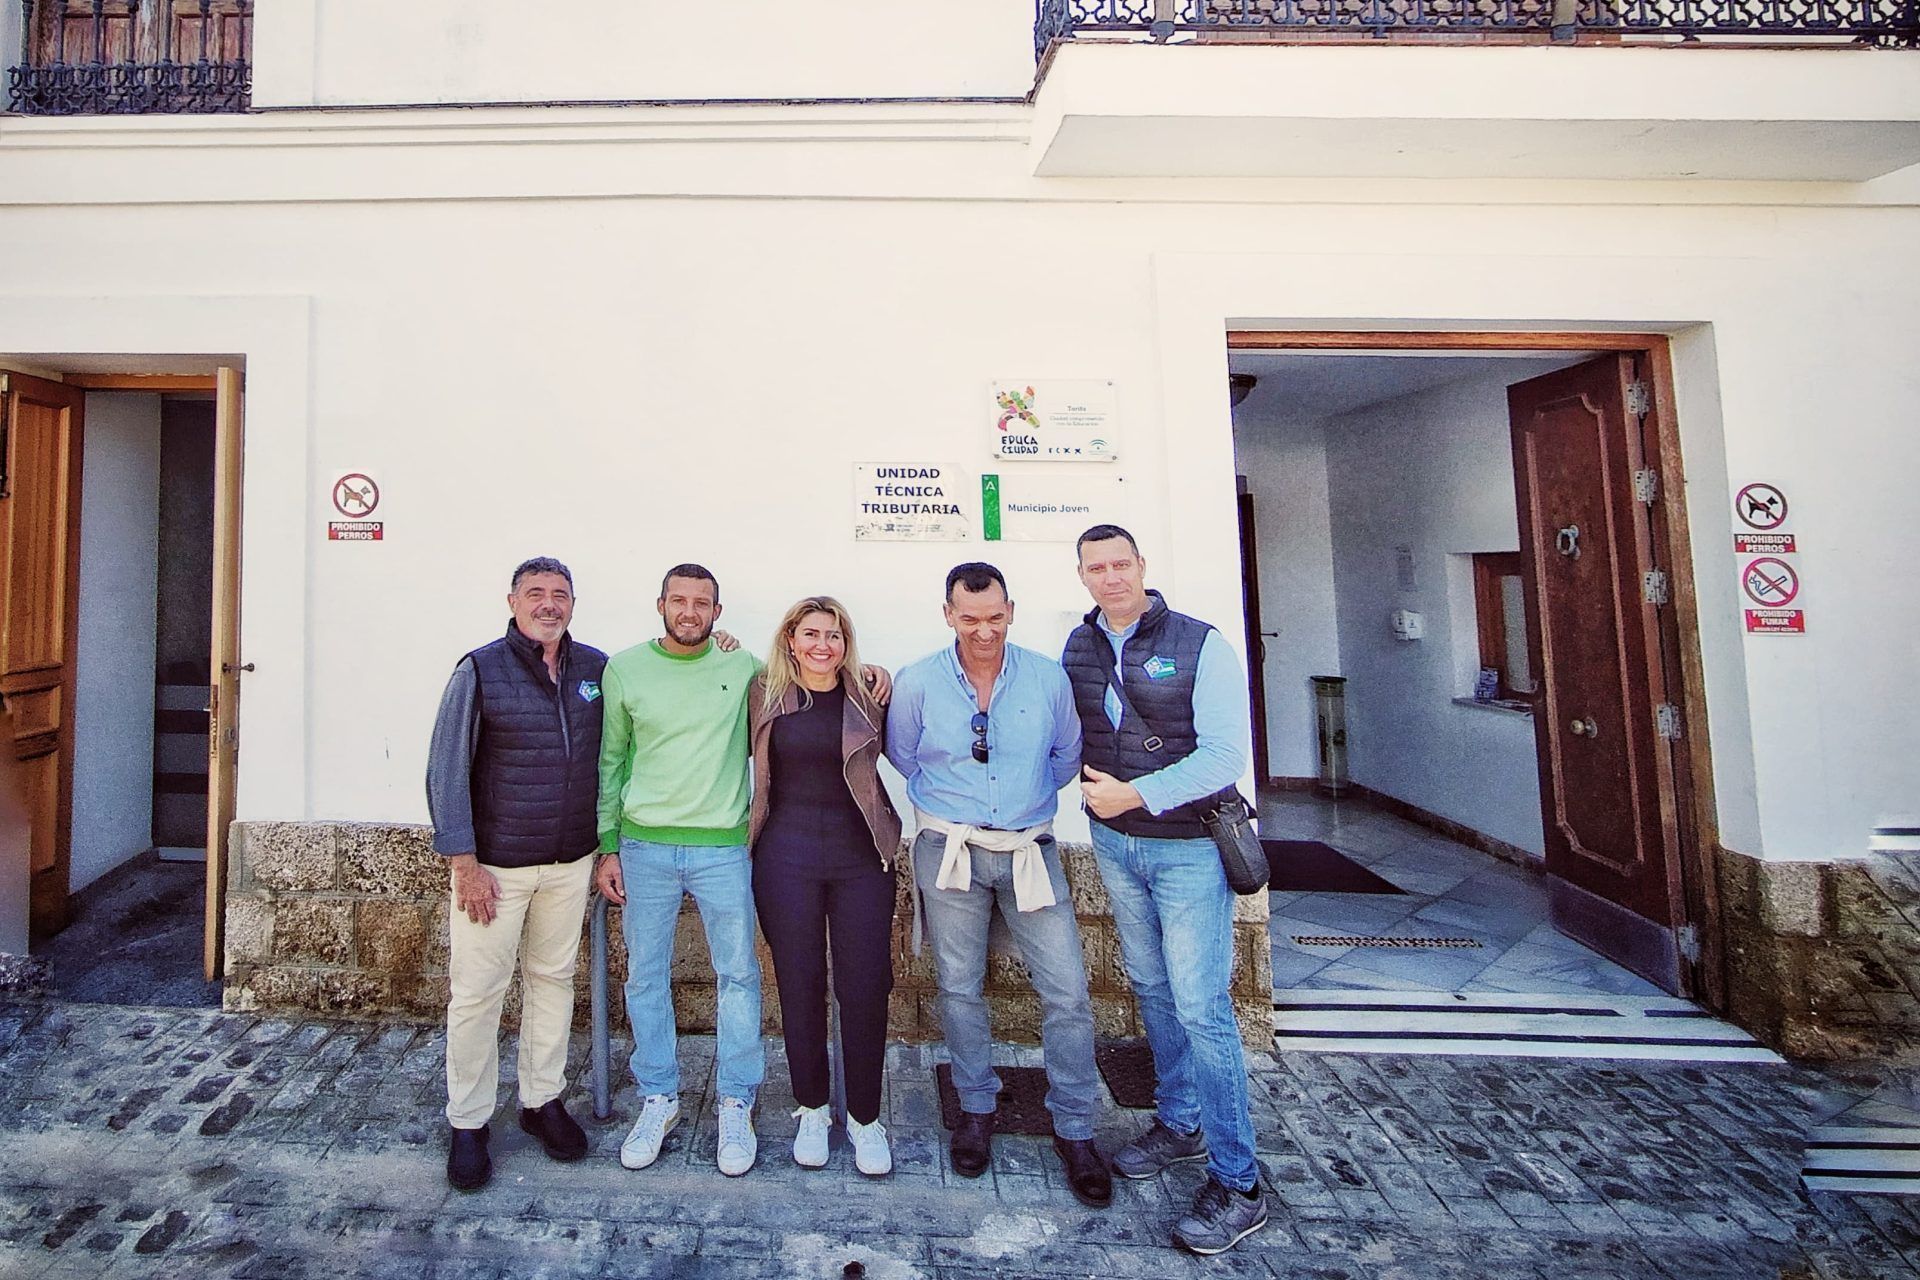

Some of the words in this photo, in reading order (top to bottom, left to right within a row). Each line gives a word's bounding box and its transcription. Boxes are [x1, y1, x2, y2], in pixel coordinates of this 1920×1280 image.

[1001, 435, 1038, 445] EDUCA
[1001, 445, 1039, 454] CIUDAD
[877, 468, 940, 479] UNIDAD
[875, 482, 944, 497] TÉCNICA
[985, 481, 996, 491] A
[861, 503, 960, 515] TRIBUTARIA
[1008, 503, 1057, 514] Municipio
[1059, 504, 1090, 513] Joven
[331, 522, 381, 531] PROHIBIDO
[338, 531, 374, 540] PERROS
[1737, 535, 1792, 544] PROHIBIDO
[1745, 544, 1786, 553] PERROS
[1752, 610, 1796, 618] PROHIBIDO
